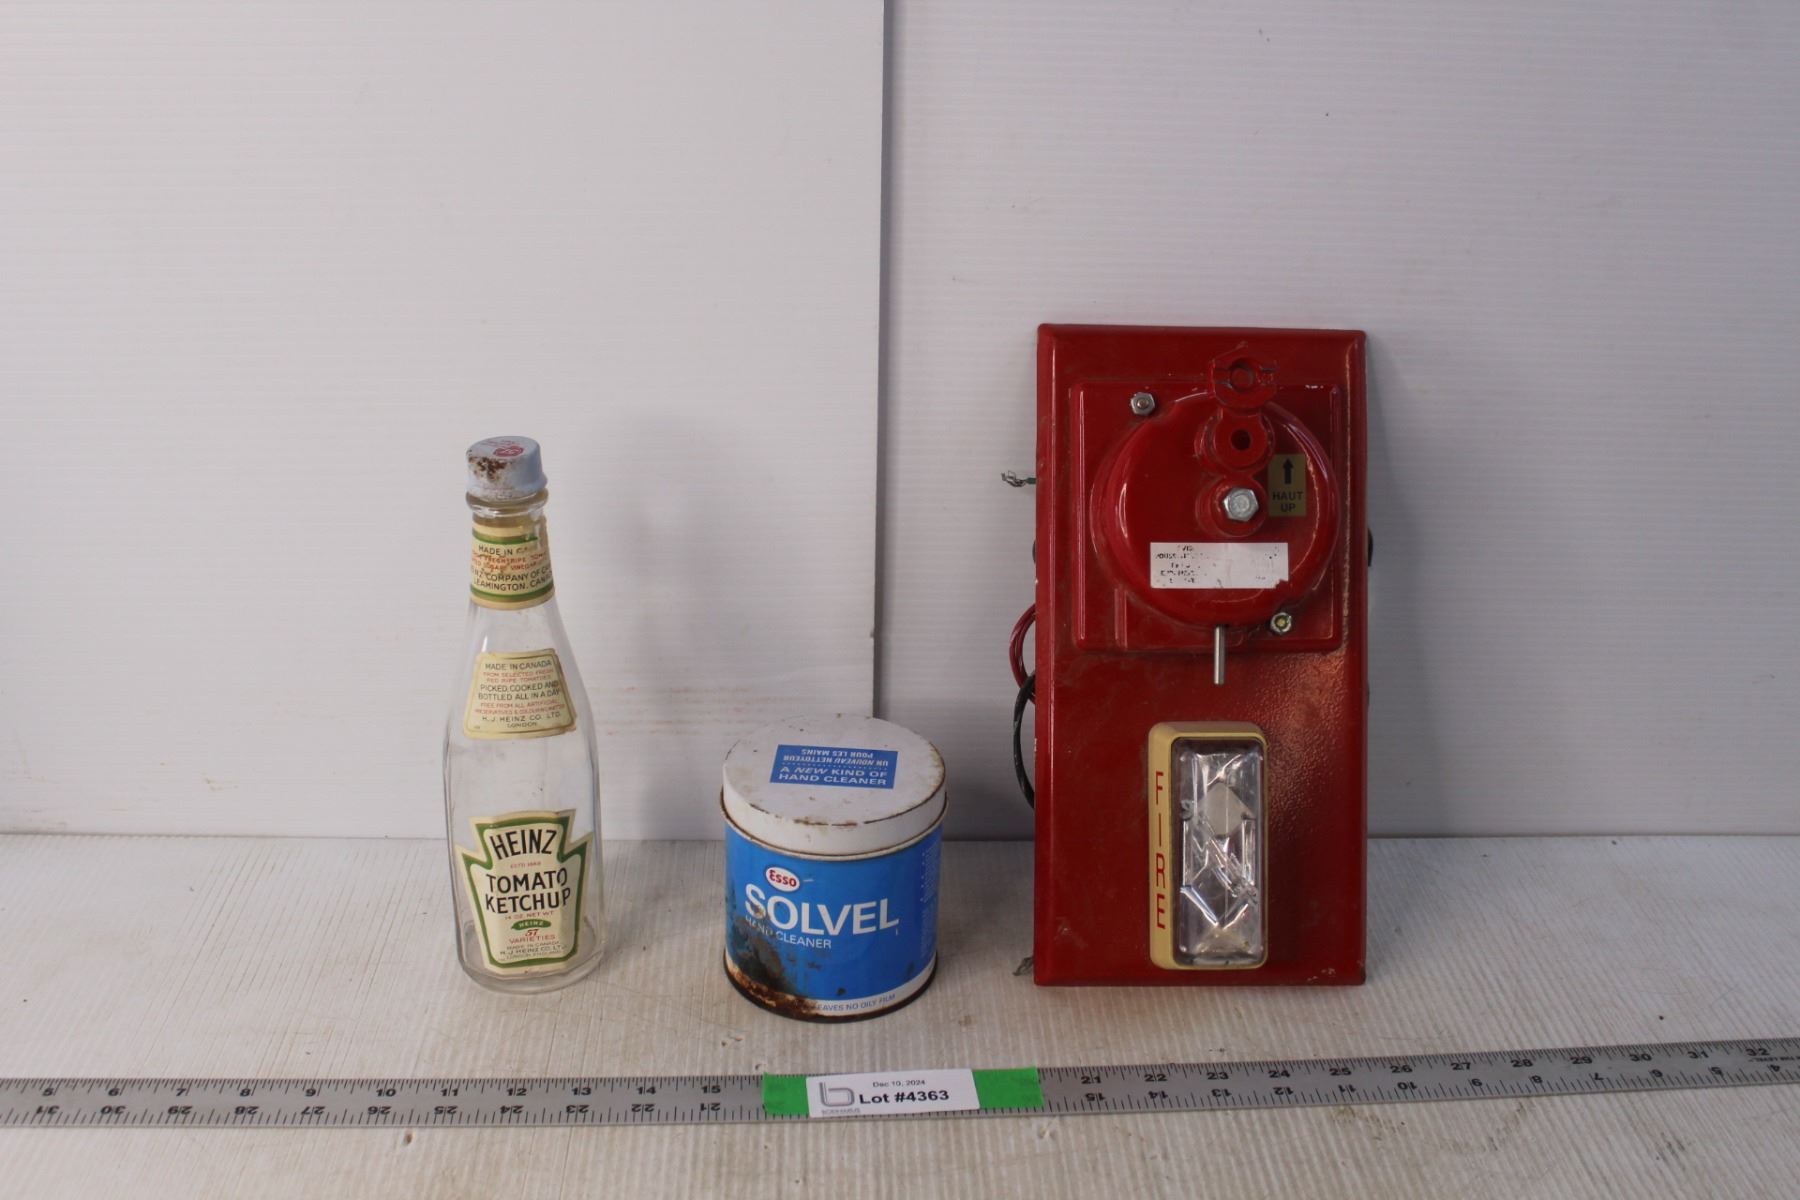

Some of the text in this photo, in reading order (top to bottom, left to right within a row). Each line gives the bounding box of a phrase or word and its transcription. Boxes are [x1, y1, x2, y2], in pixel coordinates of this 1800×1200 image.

[1272, 490, 1304, 501] HAUT
[1280, 502, 1296, 512] UP
[479, 545, 500, 556] MADE
[486, 571, 529, 582] COMPANY
[530, 569, 541, 579] OF
[520, 660, 553, 669] CANADA
[510, 682, 542, 692] COOKED
[544, 680, 560, 688] AND
[478, 692, 512, 700] BOTTLED
[546, 688, 560, 697] DAY
[784, 754, 832, 762] NETTOYEUR
[832, 756, 874, 766] NOUVEAU
[832, 769, 864, 777] KIND
[778, 774, 887, 785] HAND CLEANER
[490, 829, 557, 860] HEINZ
[1155, 771, 1166, 929] FIRE
[486, 867, 568, 894] TOMATO
[768, 869, 798, 888] Esso
[486, 887, 571, 914] KETCHUP
[745, 883, 900, 936] SOLVEL
[518, 920, 544, 928] HEINZ
[525, 928, 539, 936] 57
[776, 930, 832, 949] CLEANER
[812, 1003, 845, 1012] EAVES
[1081, 1048, 1770, 1084] 21 22 23 24 25 26 27 28 29 30 31 32
[42, 1085, 721, 1096] 5 6 7 8 9 10 11 12 13 14 15
[858, 1090, 950, 1104] Lot #4363
